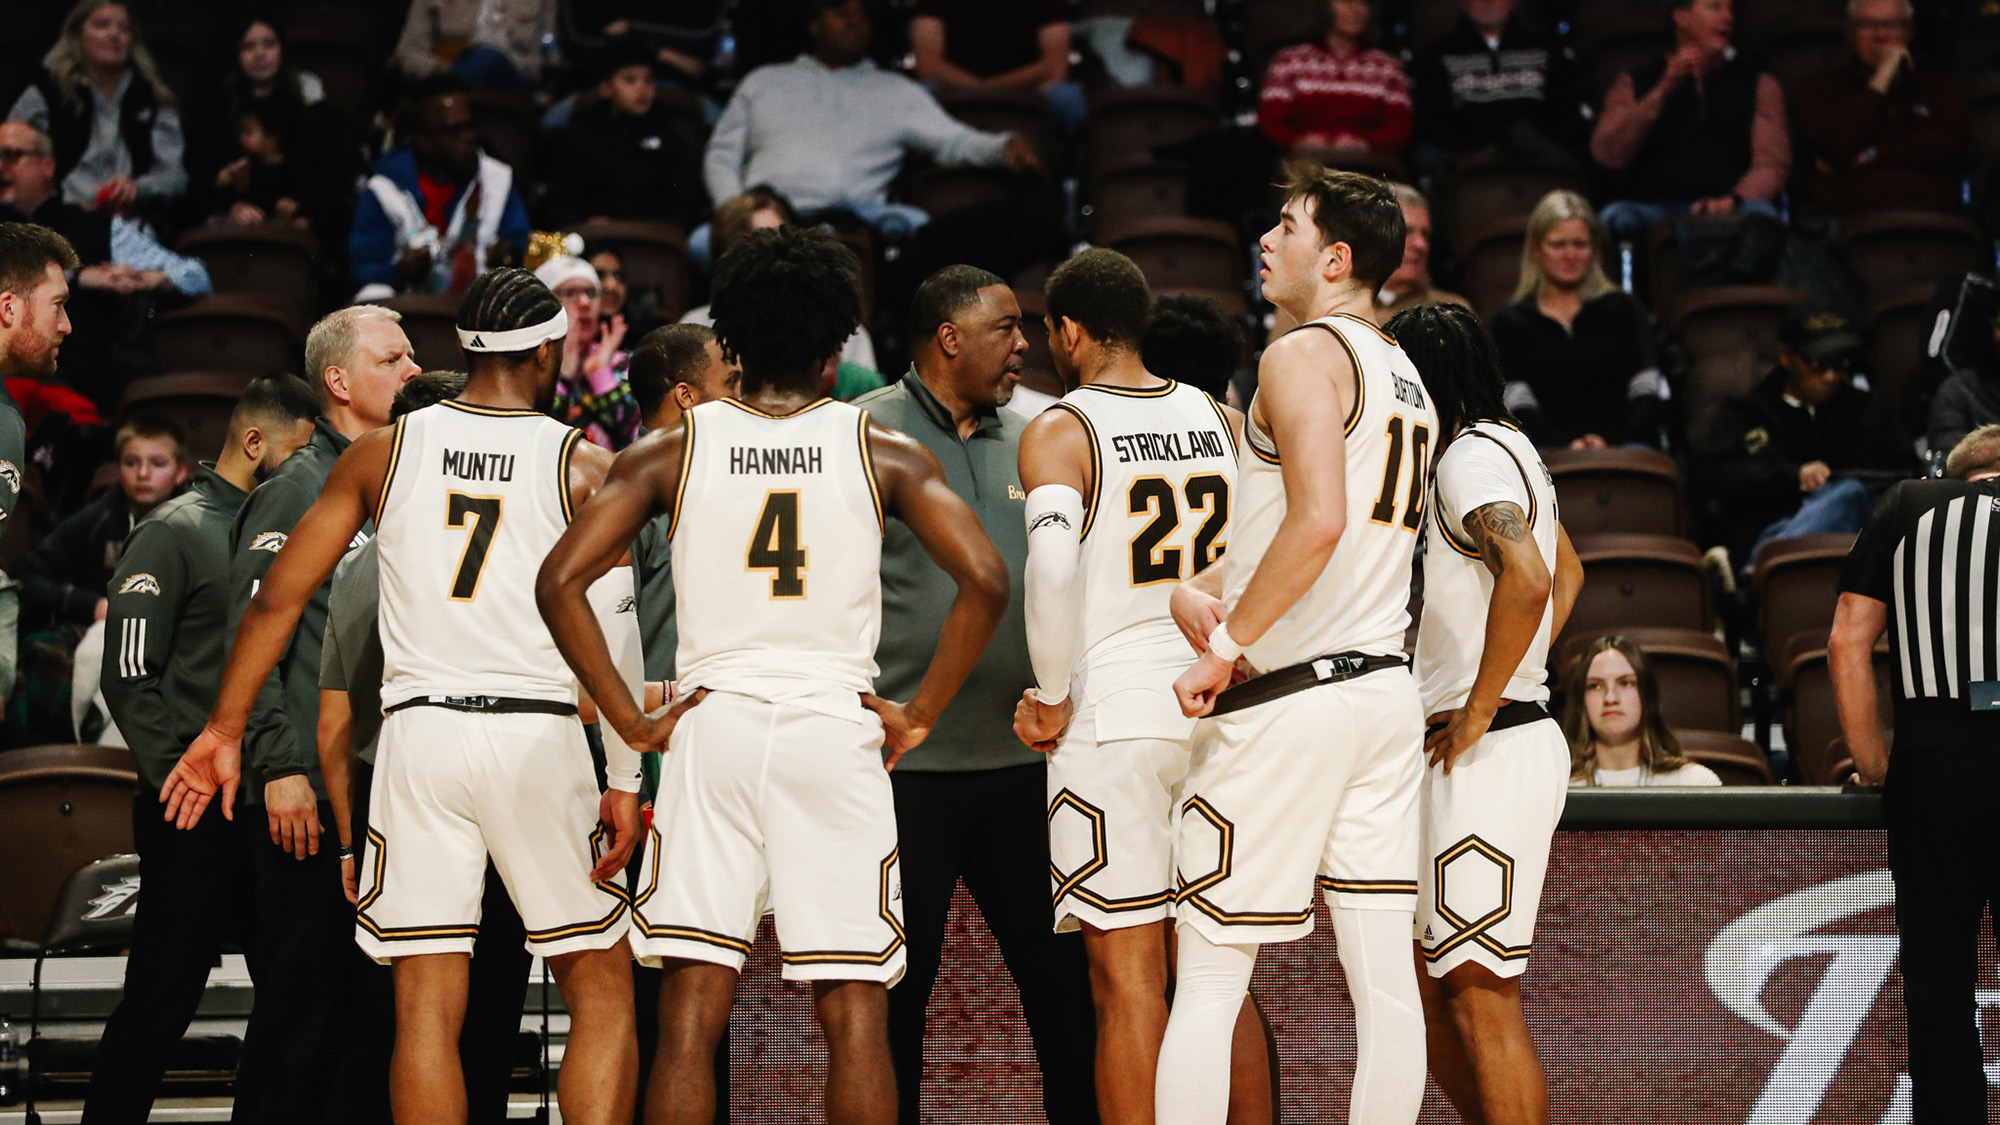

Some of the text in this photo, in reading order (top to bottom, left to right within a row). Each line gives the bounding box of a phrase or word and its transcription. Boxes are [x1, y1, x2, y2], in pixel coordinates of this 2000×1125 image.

[1391, 371, 1427, 410] BURTON
[442, 447, 515, 482] MUNTU
[730, 446, 822, 475] HANNAH
[1111, 430, 1225, 463] STRICKLAND
[1370, 411, 1429, 535] 10
[443, 488, 505, 604] 7
[743, 487, 810, 602] 4
[1125, 470, 1232, 589] 22
